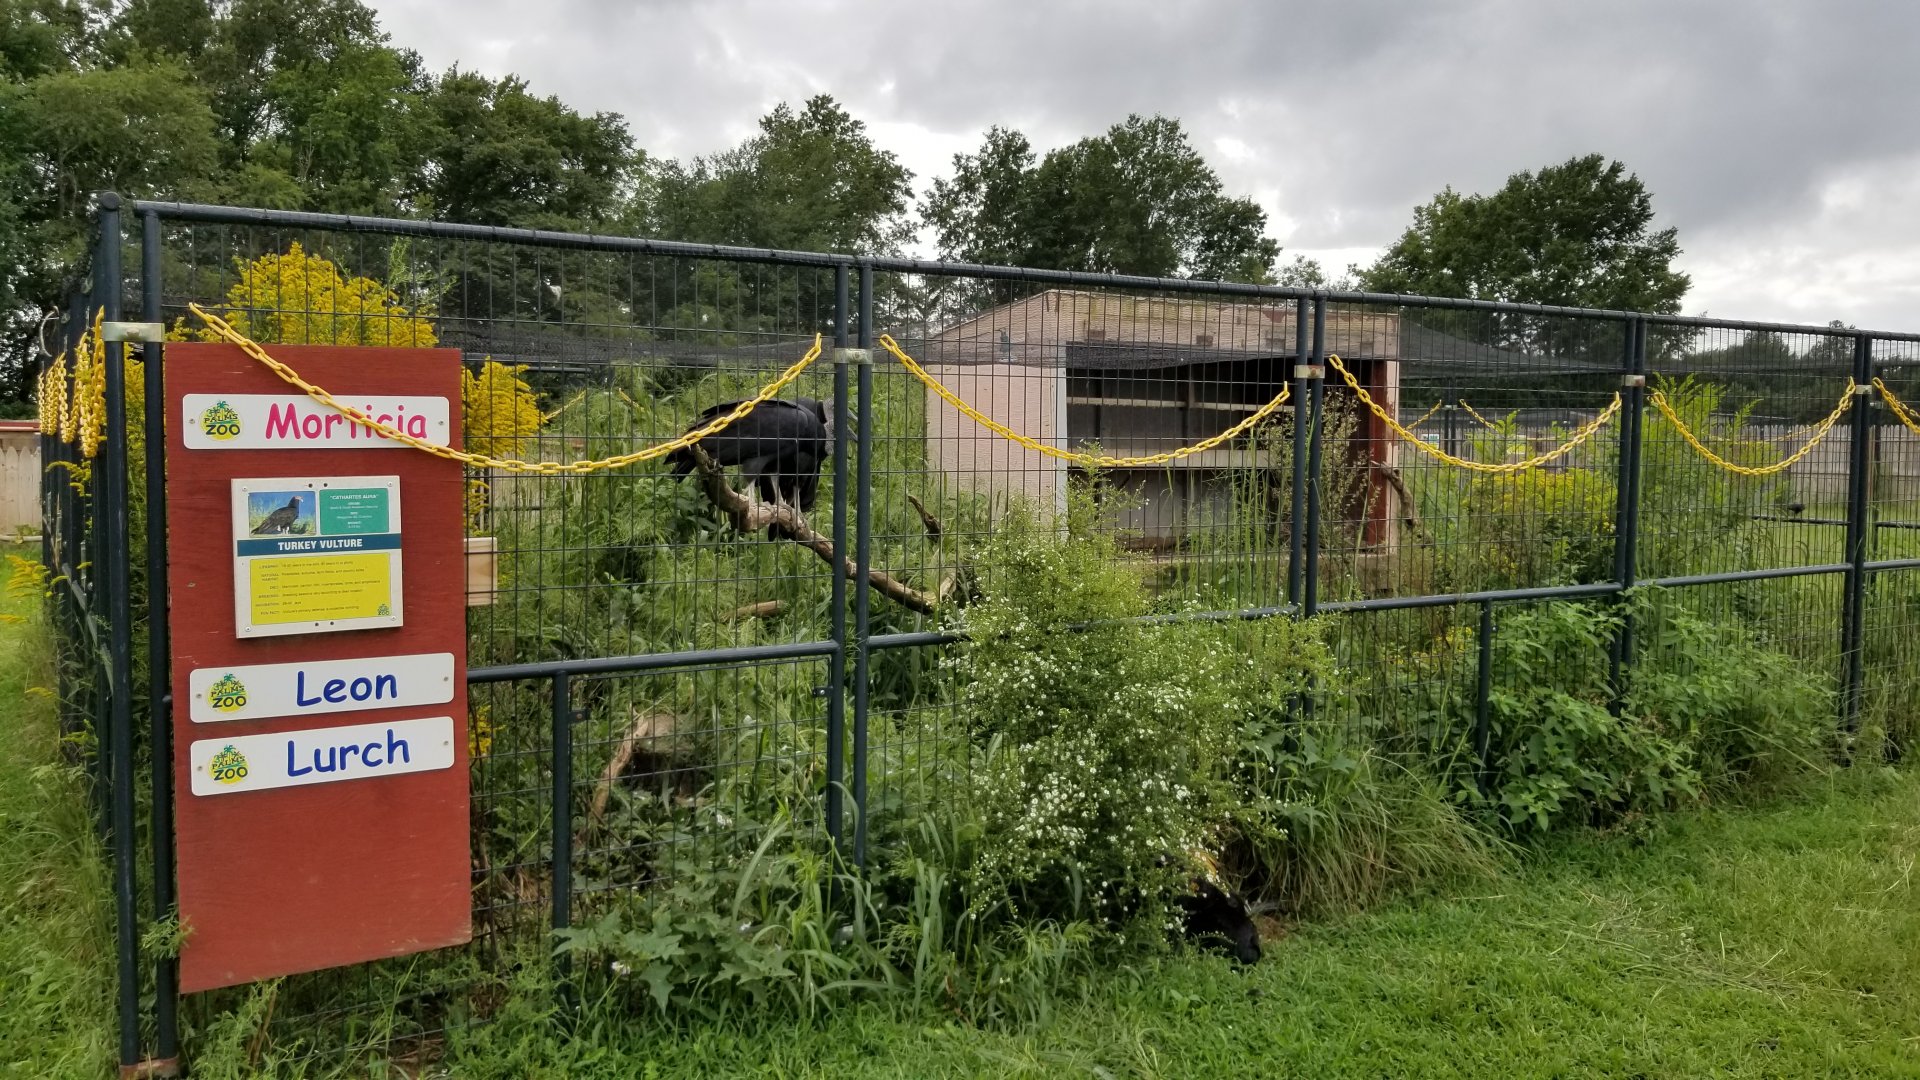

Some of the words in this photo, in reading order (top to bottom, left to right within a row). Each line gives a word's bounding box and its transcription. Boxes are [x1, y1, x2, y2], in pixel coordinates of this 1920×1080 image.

[203, 413, 239, 424] PALMS
[205, 423, 241, 436] ZOO
[277, 540, 317, 551] TURKEY
[320, 538, 363, 549] VULTURE
[210, 685, 246, 698] PALMS
[296, 670, 398, 707] Leon
[212, 695, 247, 709] ZOO
[287, 728, 411, 778] Lurch
[212, 755, 246, 770] PALMS
[213, 766, 249, 781] ZOO
